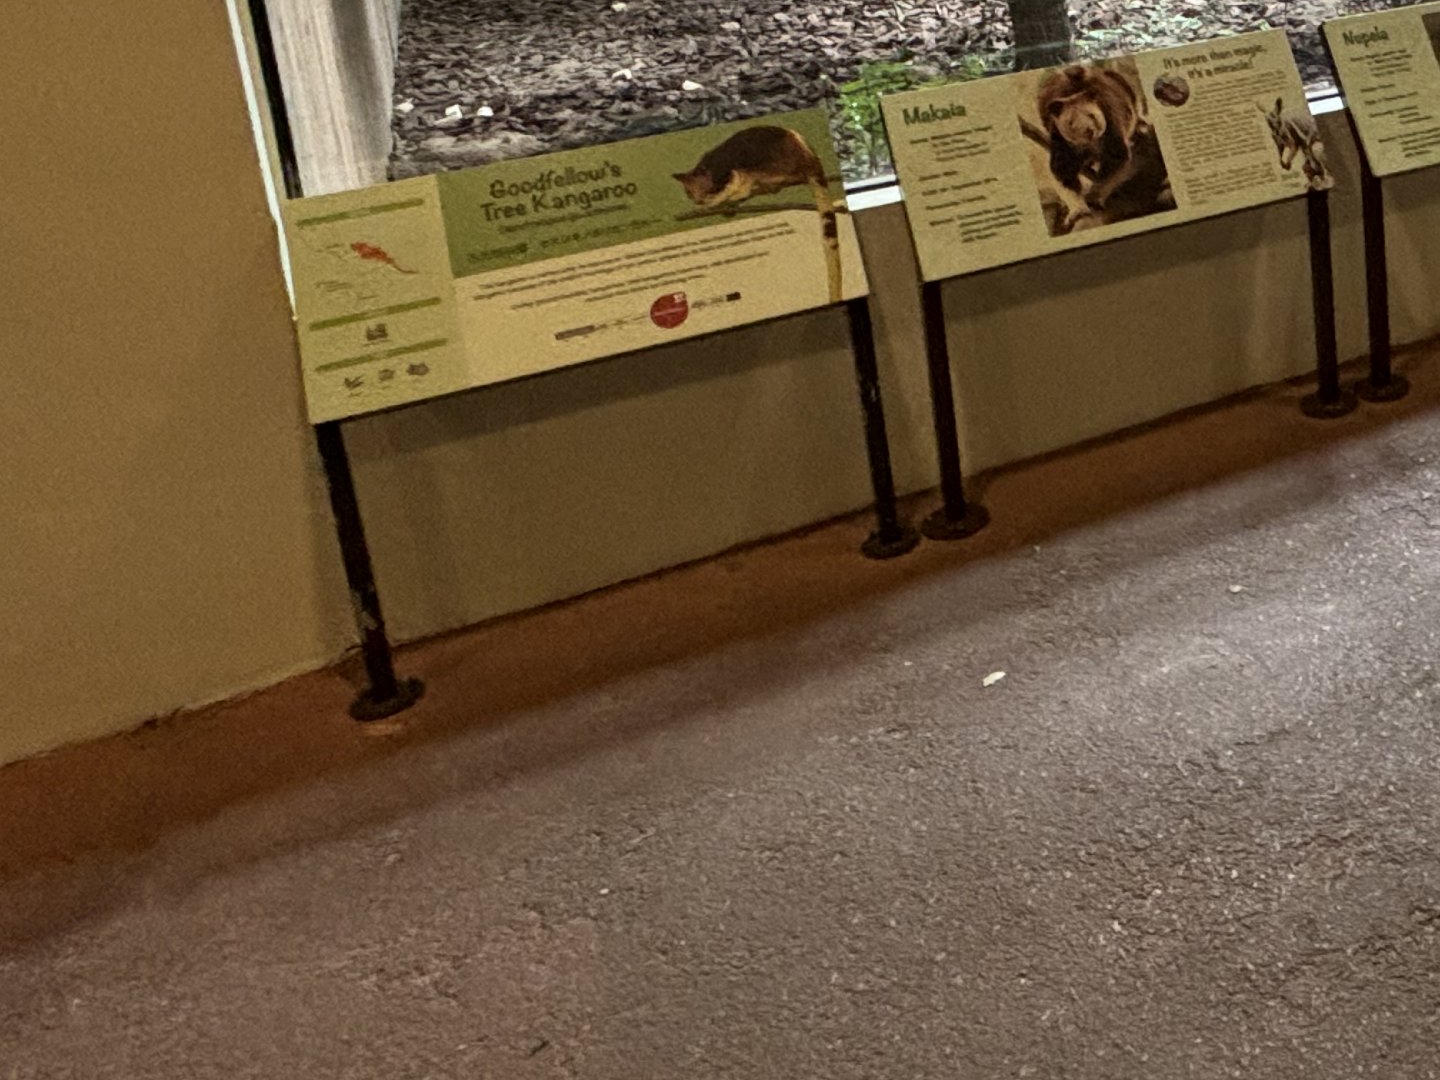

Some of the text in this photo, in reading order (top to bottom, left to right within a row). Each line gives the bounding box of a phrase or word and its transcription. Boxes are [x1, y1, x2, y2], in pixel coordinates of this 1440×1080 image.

[902, 103, 967, 126] Makaia
[489, 160, 622, 199] Goodfellow's
[480, 201, 526, 221] Tree
[532, 182, 638, 213] Kangaroo
